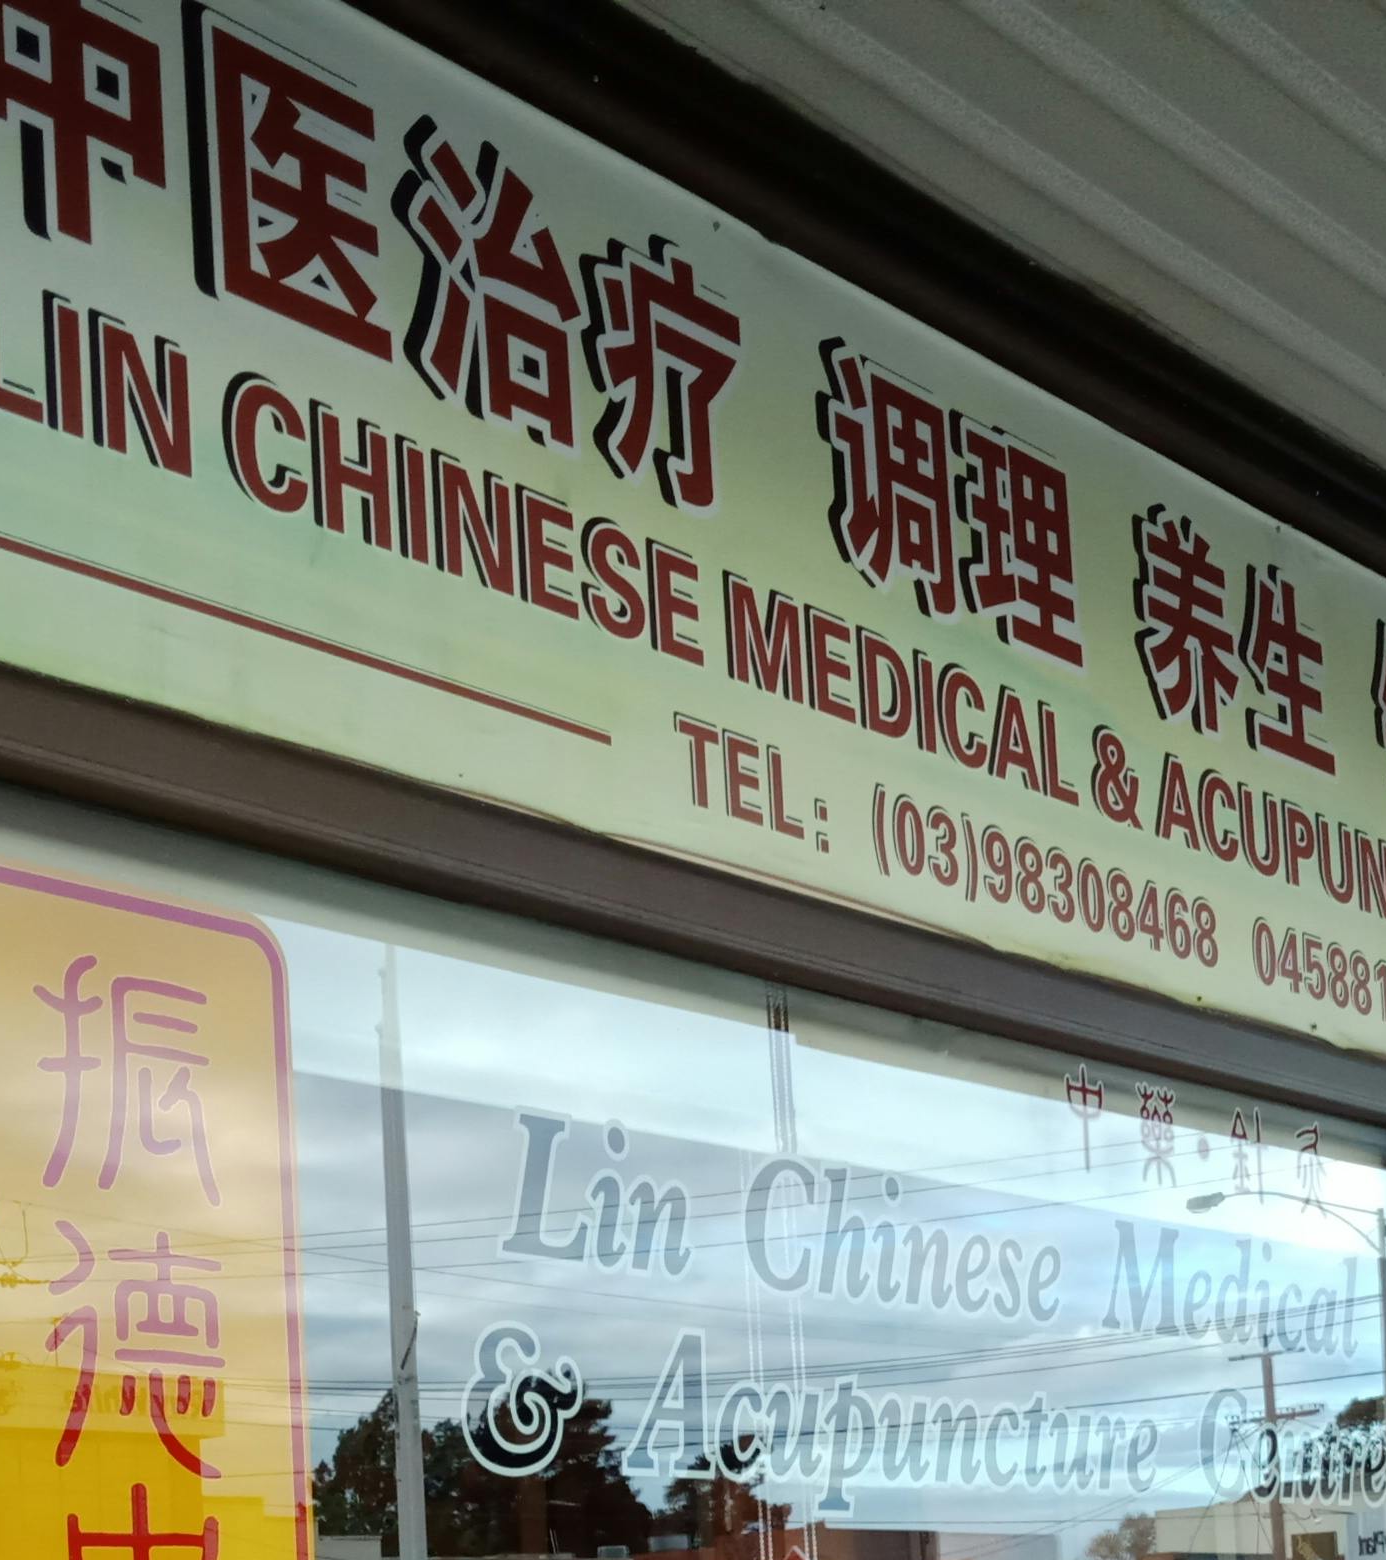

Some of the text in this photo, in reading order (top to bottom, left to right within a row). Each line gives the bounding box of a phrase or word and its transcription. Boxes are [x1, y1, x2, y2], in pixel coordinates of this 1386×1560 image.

[222, 371, 704, 667] CHINESE
[722, 570, 1079, 807] MEDICAL
[1092, 724, 1143, 831] &
[816, 337, 1082, 669] 调理
[1133, 503, 1335, 775] 养生
[872, 783, 1219, 967] (03)98308468
[497, 1105, 1361, 1361] Lin Chinese Medical
[460, 1320, 583, 1478] &
[622, 1327, 1159, 1518] Acupuncture
